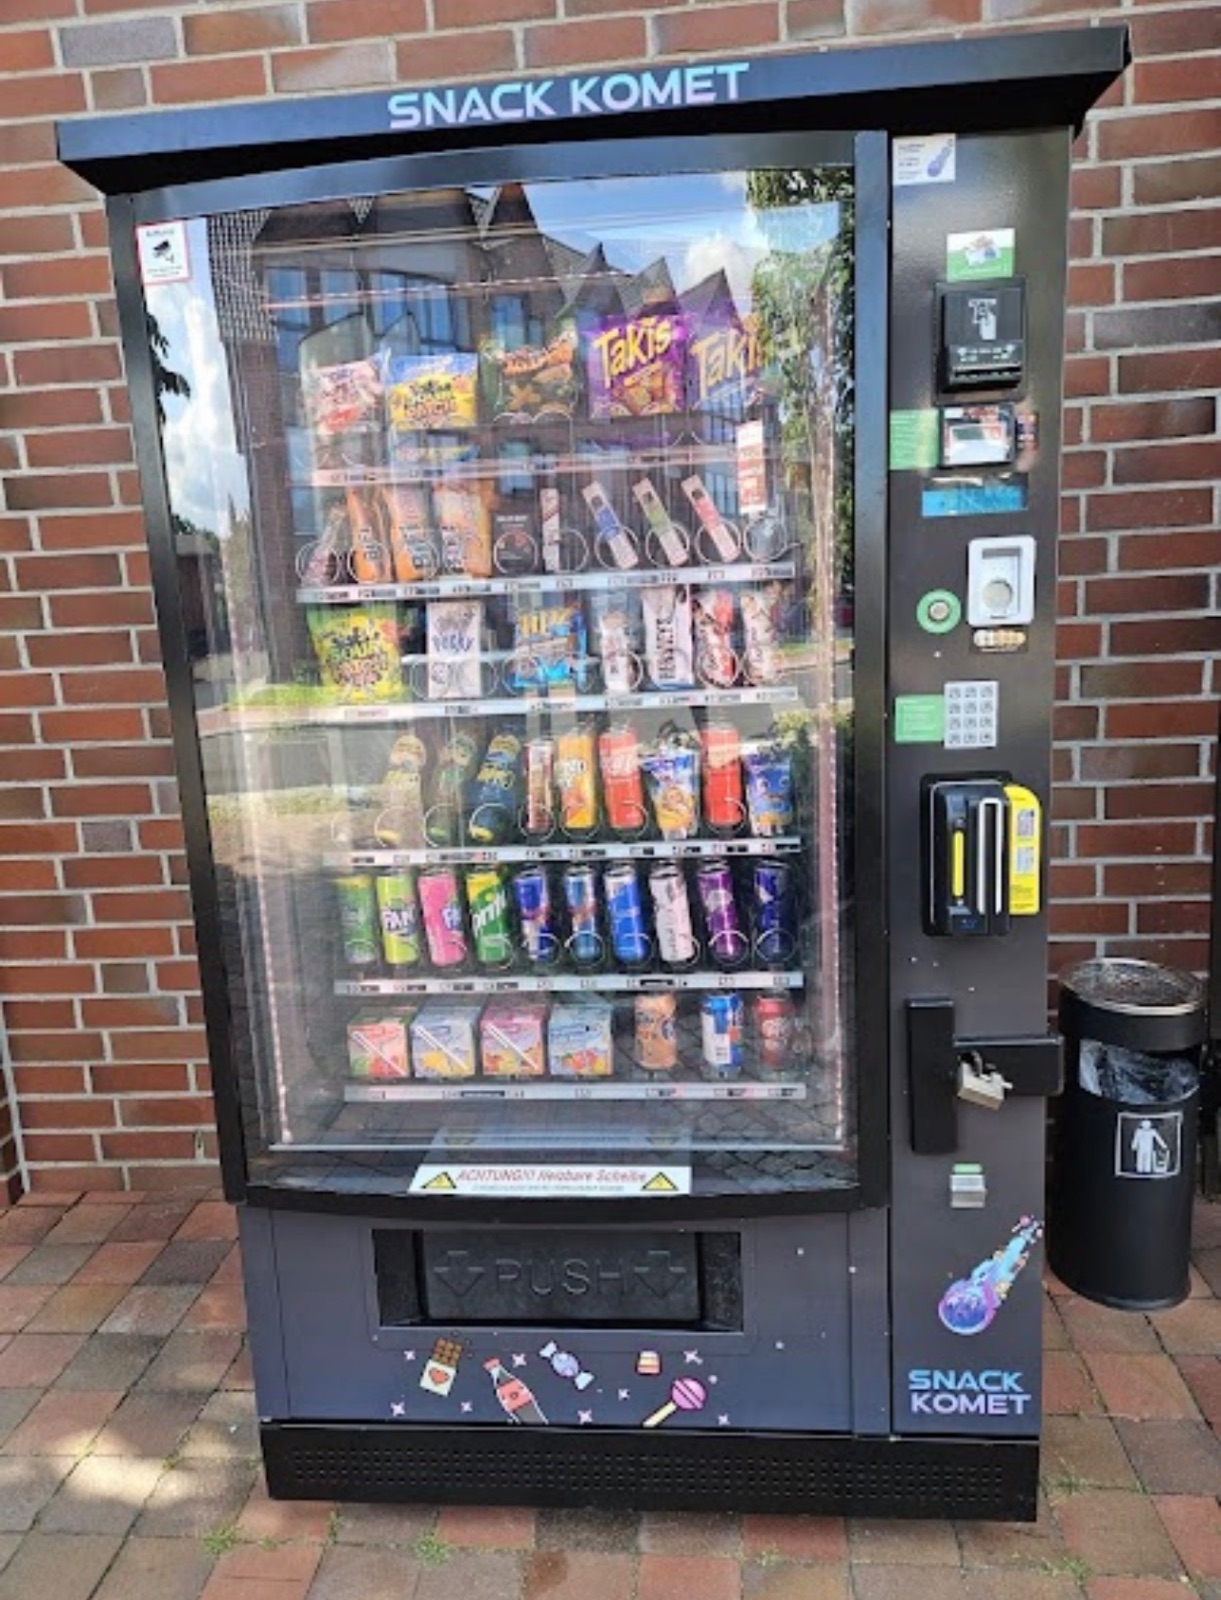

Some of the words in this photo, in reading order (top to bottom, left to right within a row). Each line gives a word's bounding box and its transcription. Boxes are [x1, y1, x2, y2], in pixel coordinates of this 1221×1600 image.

[388, 80, 556, 129] SNACK
[570, 62, 750, 114] KOMET
[592, 316, 672, 390] Takis
[690, 313, 764, 401] Taki
[496, 1258, 628, 1295] PUSH
[908, 1369, 1025, 1392] SNACK
[910, 1391, 1031, 1415] KOMET
